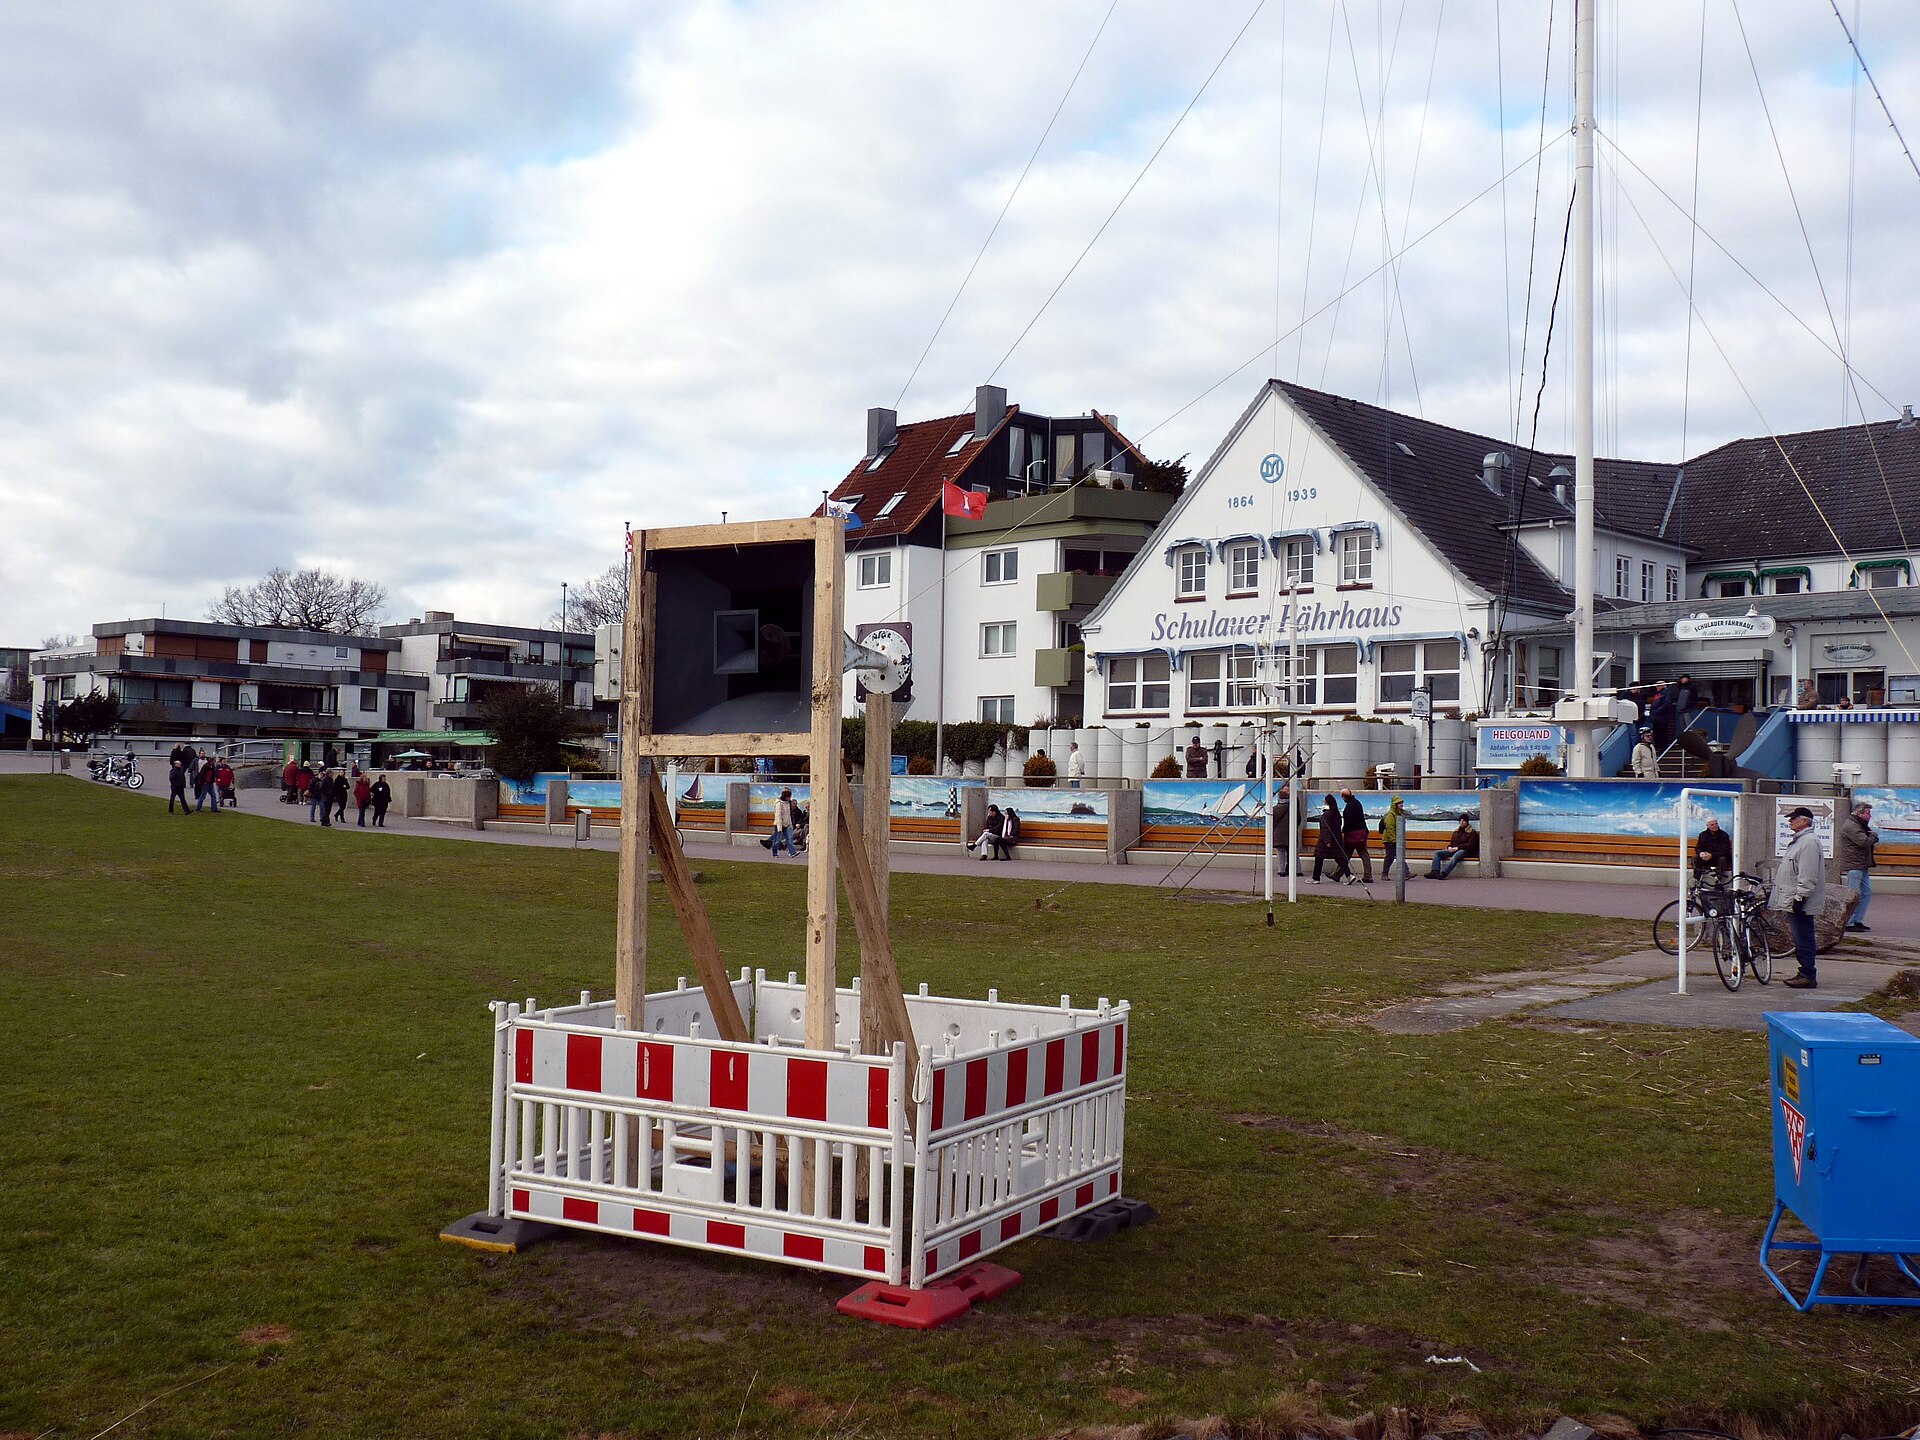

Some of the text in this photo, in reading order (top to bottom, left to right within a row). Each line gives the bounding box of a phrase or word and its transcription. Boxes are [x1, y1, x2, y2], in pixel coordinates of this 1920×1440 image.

[1227, 487, 1317, 509] 1864 1939
[1150, 600, 1402, 641] Schulauer Fährhaus
[1694, 620, 1724, 632] SCHULAUER
[1493, 730, 1550, 740] HELGOLAND
[1511, 744, 1529, 752] täglich
